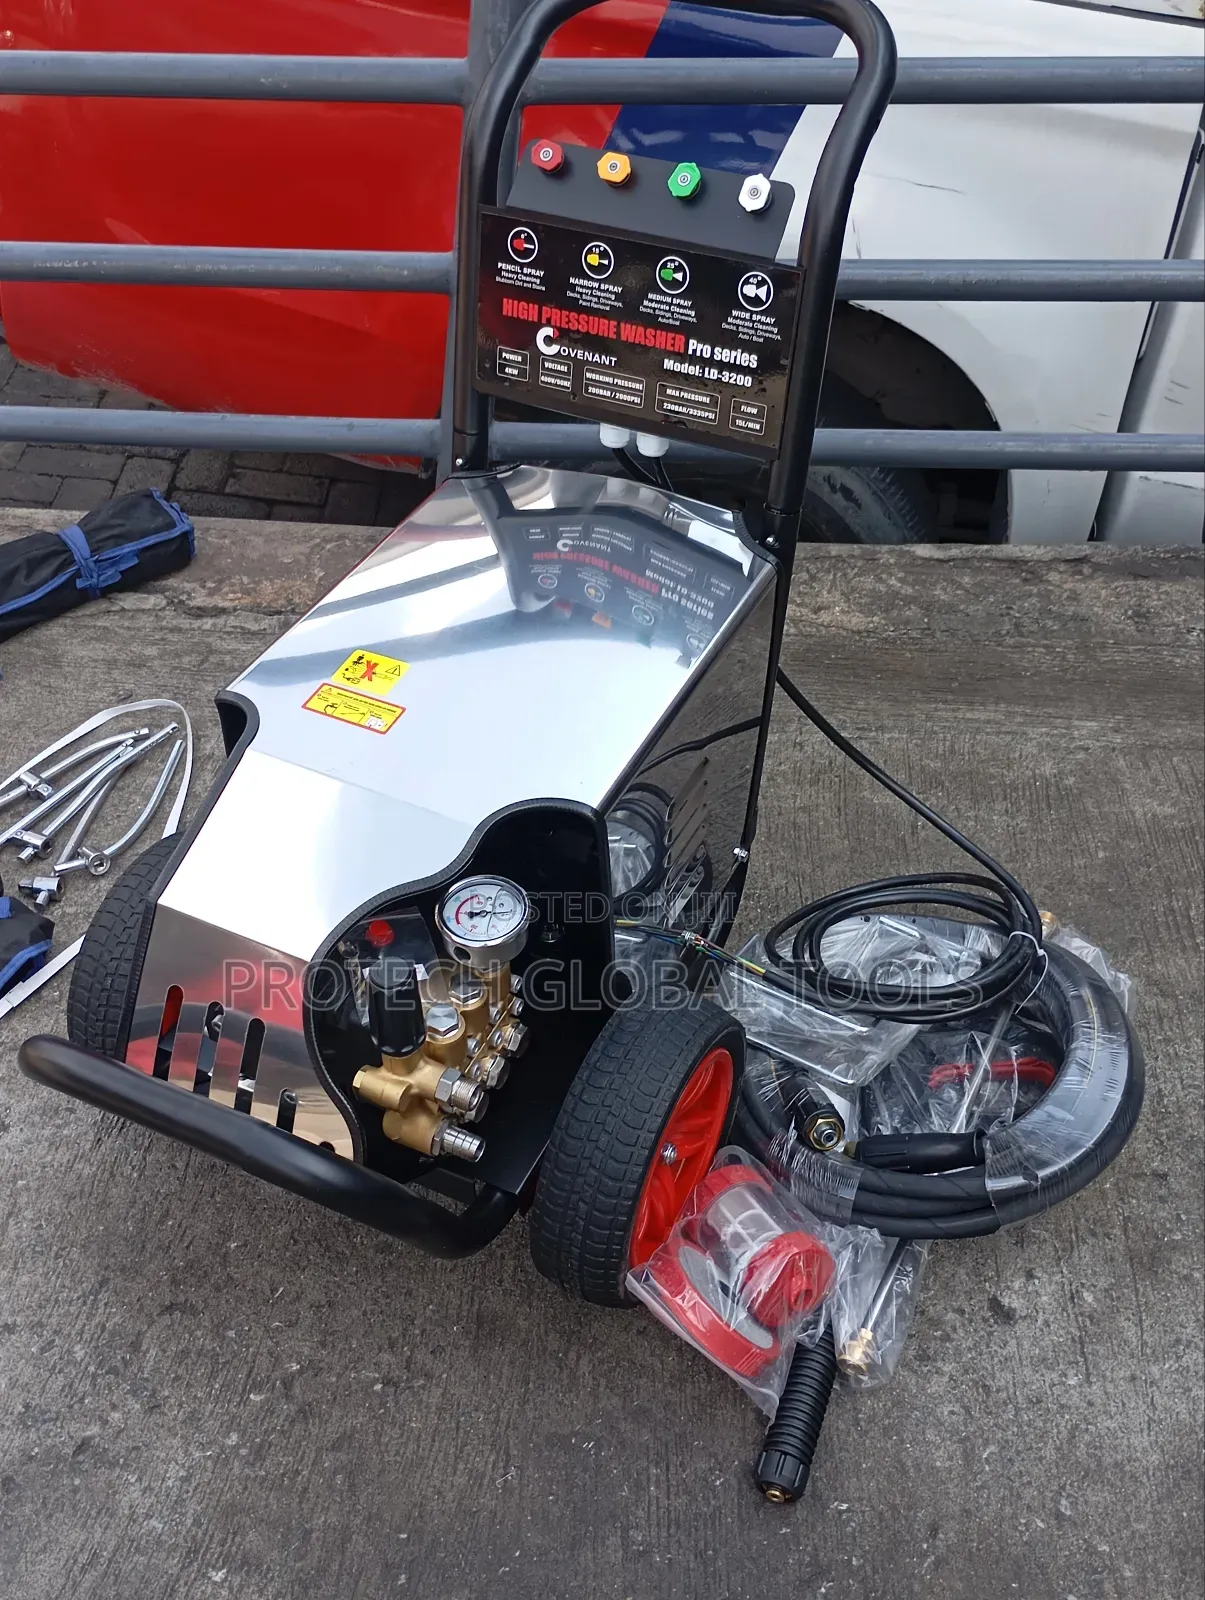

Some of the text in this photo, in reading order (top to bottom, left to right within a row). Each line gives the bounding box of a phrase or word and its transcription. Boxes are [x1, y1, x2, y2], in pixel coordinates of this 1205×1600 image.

[497, 262, 545, 278] PENCIL SPRAY
[501, 271, 541, 285] Heavy Cleaning
[569, 277, 623, 294] NARROW SPRAY
[575, 285, 616, 300] Heavy Cleaning
[643, 299, 696, 317] Moderate Cleaning
[647, 292, 693, 308] MEDIUM SPRAY
[727, 316, 779, 334] Moderate Cleaning
[731, 310, 776, 325] WIDE SPRAY
[502, 298, 758, 369] HIGH PRESSURE WASHER Pro series
[502, 351, 522, 363] POWER
[544, 361, 569, 373] VOLTAGE
[663, 358, 753, 388] Model: LD-3200
[585, 371, 643, 391] WORKING PRESSURE
[666, 388, 711, 404] MAX PRESSURE
[740, 405, 758, 415] FLOW
